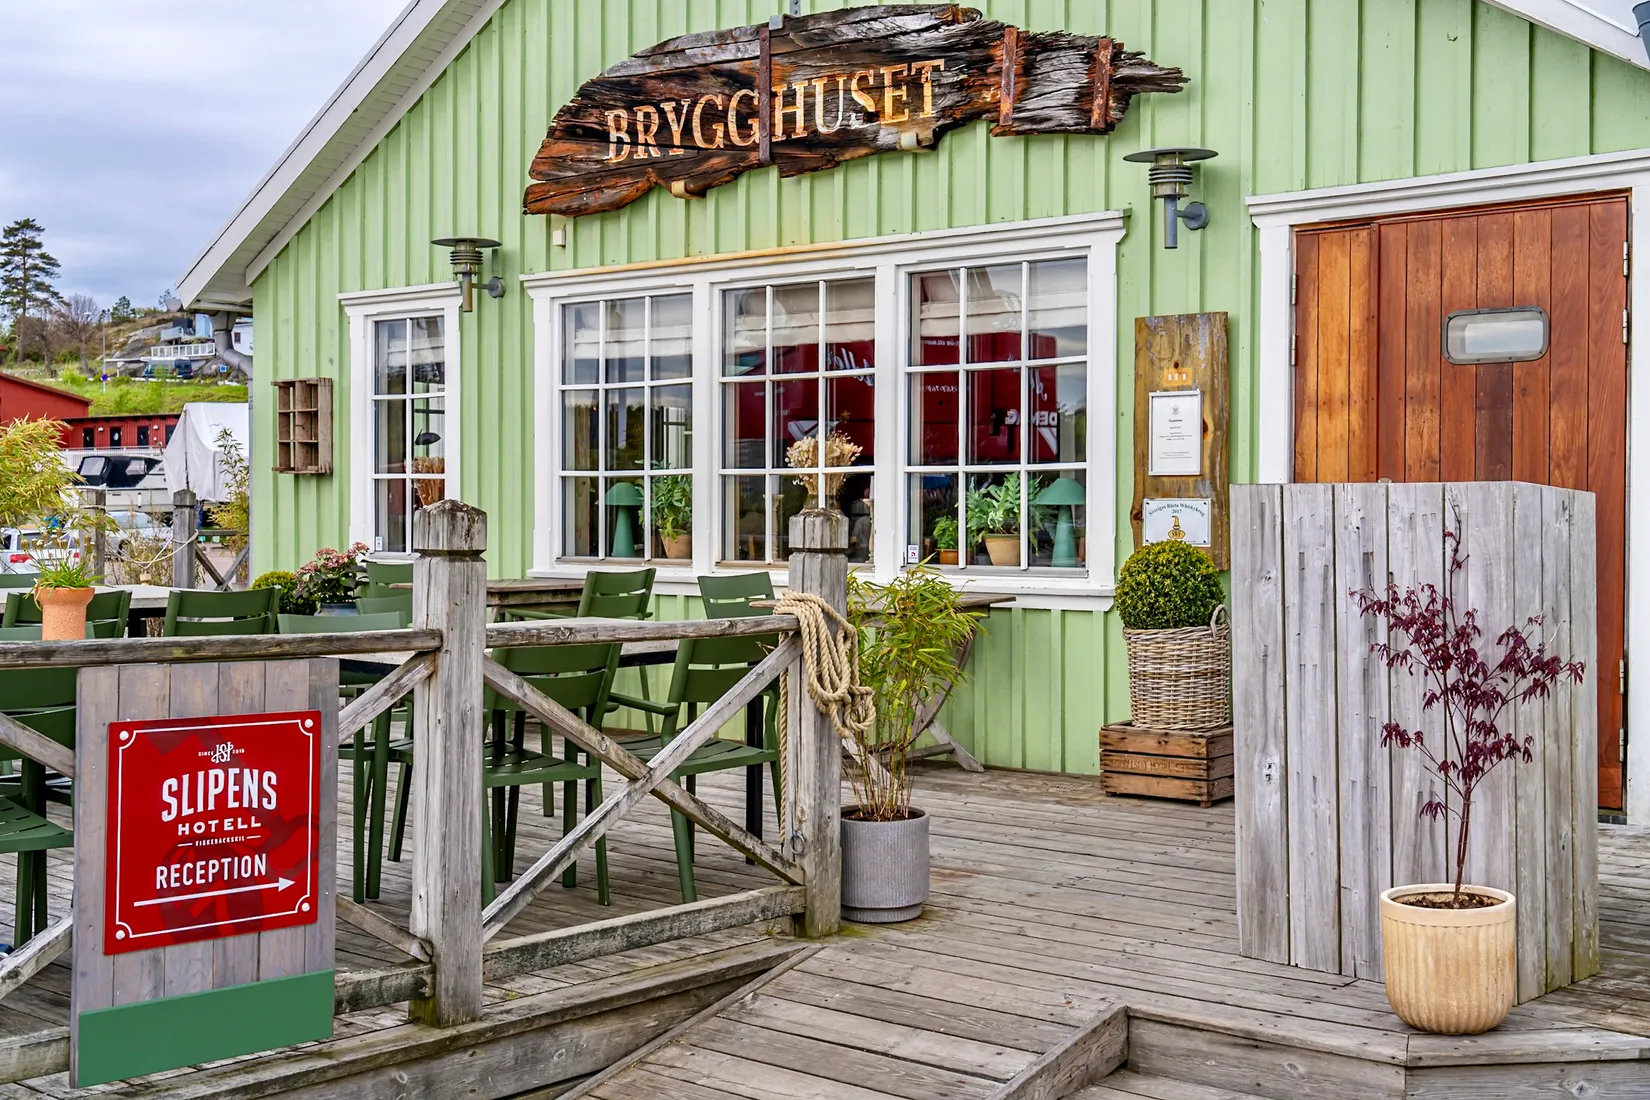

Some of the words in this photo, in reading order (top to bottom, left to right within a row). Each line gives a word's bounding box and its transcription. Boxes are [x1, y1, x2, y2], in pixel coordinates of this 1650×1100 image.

[603, 58, 945, 164] BRYGGHUSET
[161, 767, 277, 822] SLIPENS
[177, 815, 262, 836] HOTELL
[156, 853, 267, 890] RECEPTION
